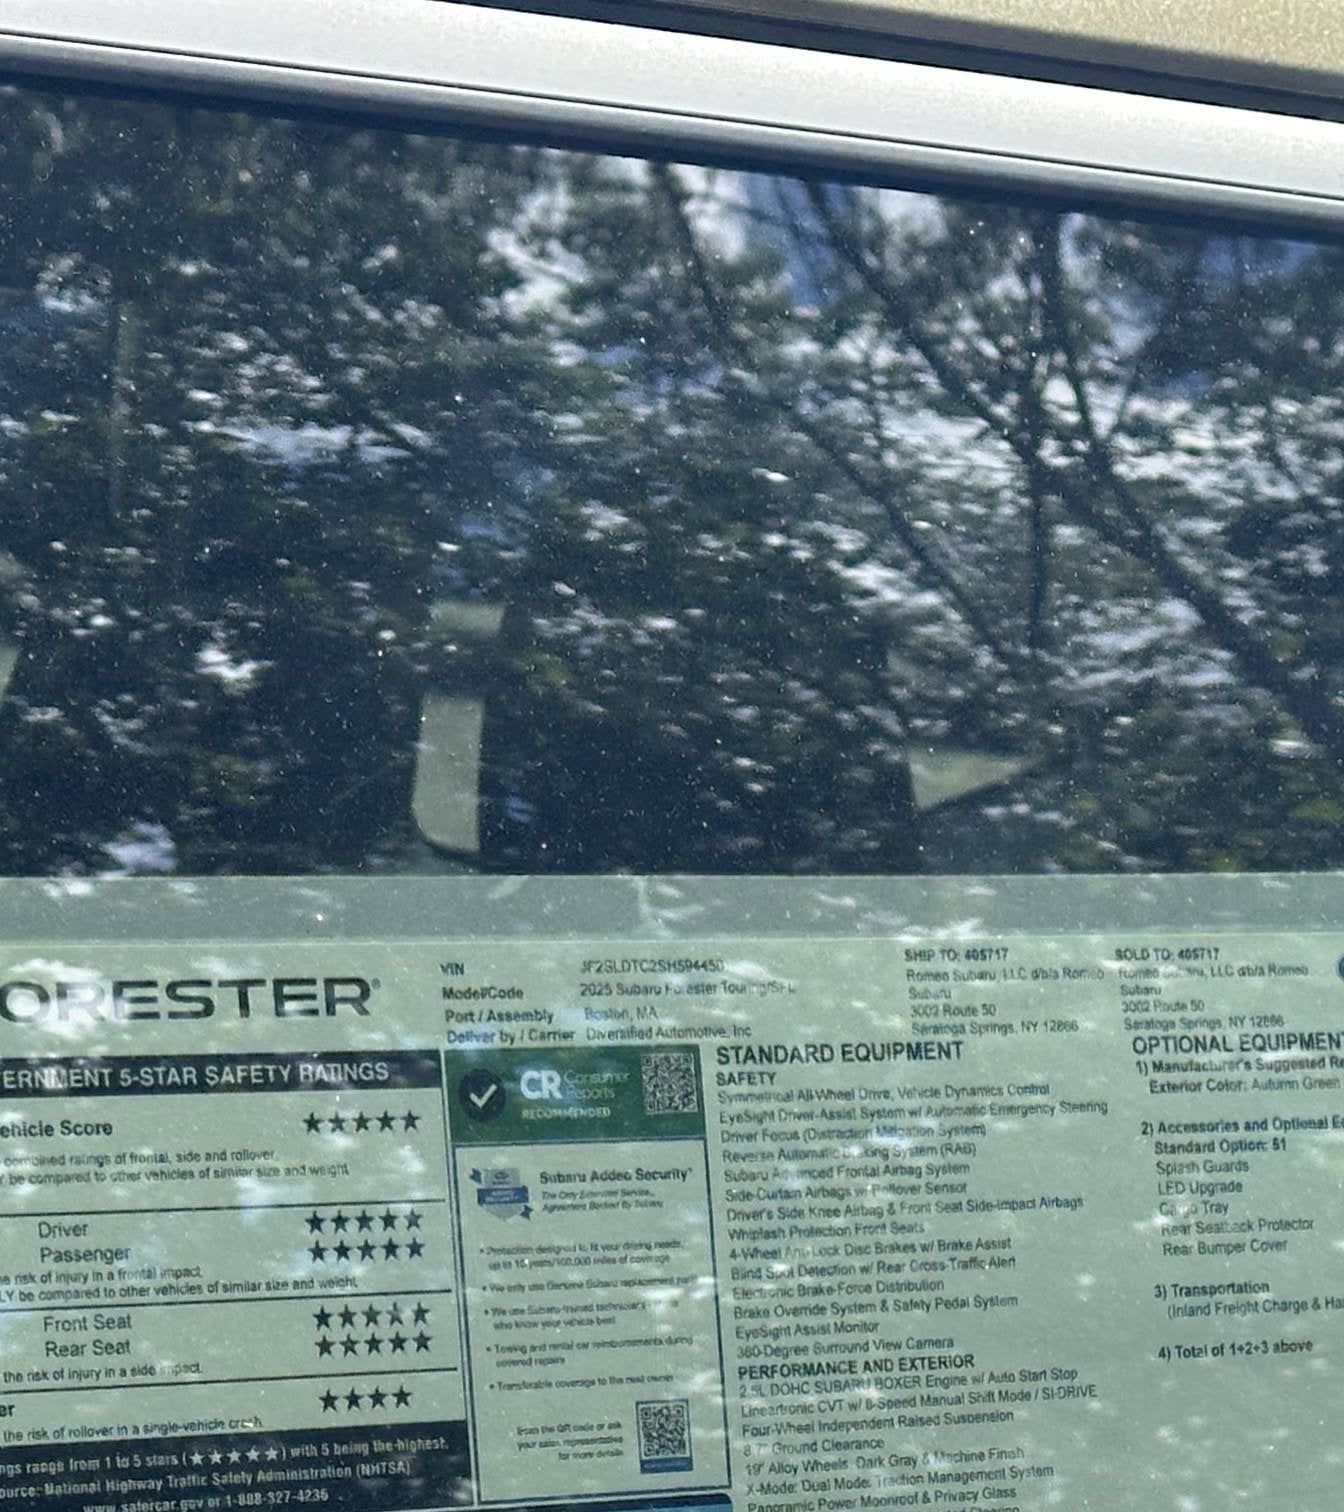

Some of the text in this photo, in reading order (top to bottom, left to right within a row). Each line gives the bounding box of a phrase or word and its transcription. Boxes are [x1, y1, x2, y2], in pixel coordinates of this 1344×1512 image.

[438, 961, 465, 976] VIN
[715, 1039, 964, 1066] STANDARD EQUIPMENT
[1131, 1033, 1234, 1055] OPTIONAL
[119, 1064, 198, 1087] 5-STAR
[204, 1062, 291, 1086] SAFETY
[297, 1060, 389, 1085] RATINGS
[519, 1068, 563, 1100] CR
[714, 1070, 777, 1087] SAFETY
[58, 1118, 113, 1137] Score
[36, 1220, 89, 1239] Driver
[39, 1245, 131, 1266] Passenger
[1169, 1280, 1270, 1298] Transportation
[42, 1312, 132, 1333] Front Seat
[44, 1337, 131, 1358] Rear Seat
[736, 1352, 975, 1380] PERFORMANCE AND EXTERIOR
